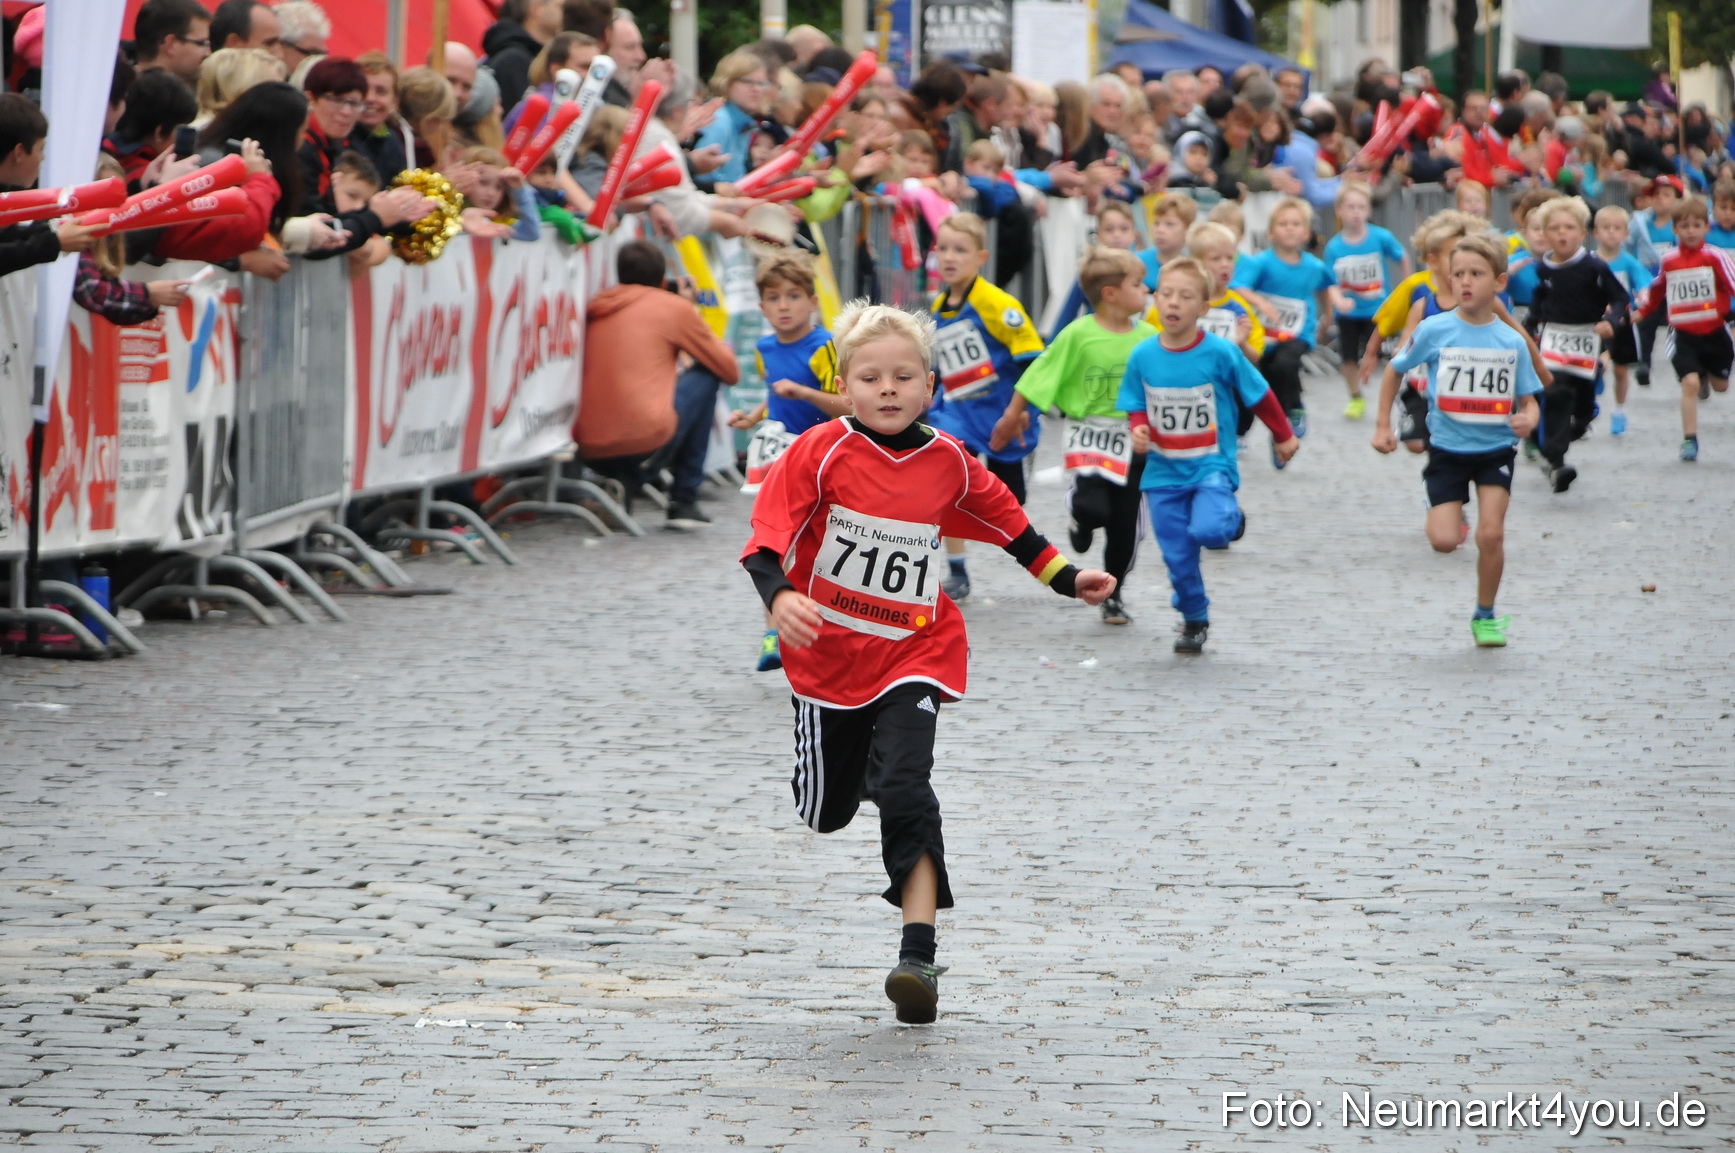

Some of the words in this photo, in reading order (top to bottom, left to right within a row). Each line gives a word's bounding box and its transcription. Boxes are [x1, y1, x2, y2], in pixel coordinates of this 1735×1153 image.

[108, 205, 141, 226] Audi
[142, 191, 173, 212] BKK
[1670, 280, 1711, 301] 7095
[1549, 332, 1594, 353] 7236
[1447, 366, 1509, 394] 7146
[1068, 425, 1127, 456] 7006
[829, 515, 868, 538] PARTL
[871, 529, 928, 548] Neumarkt
[830, 535, 929, 597] 7161
[830, 591, 910, 625] Johannes
